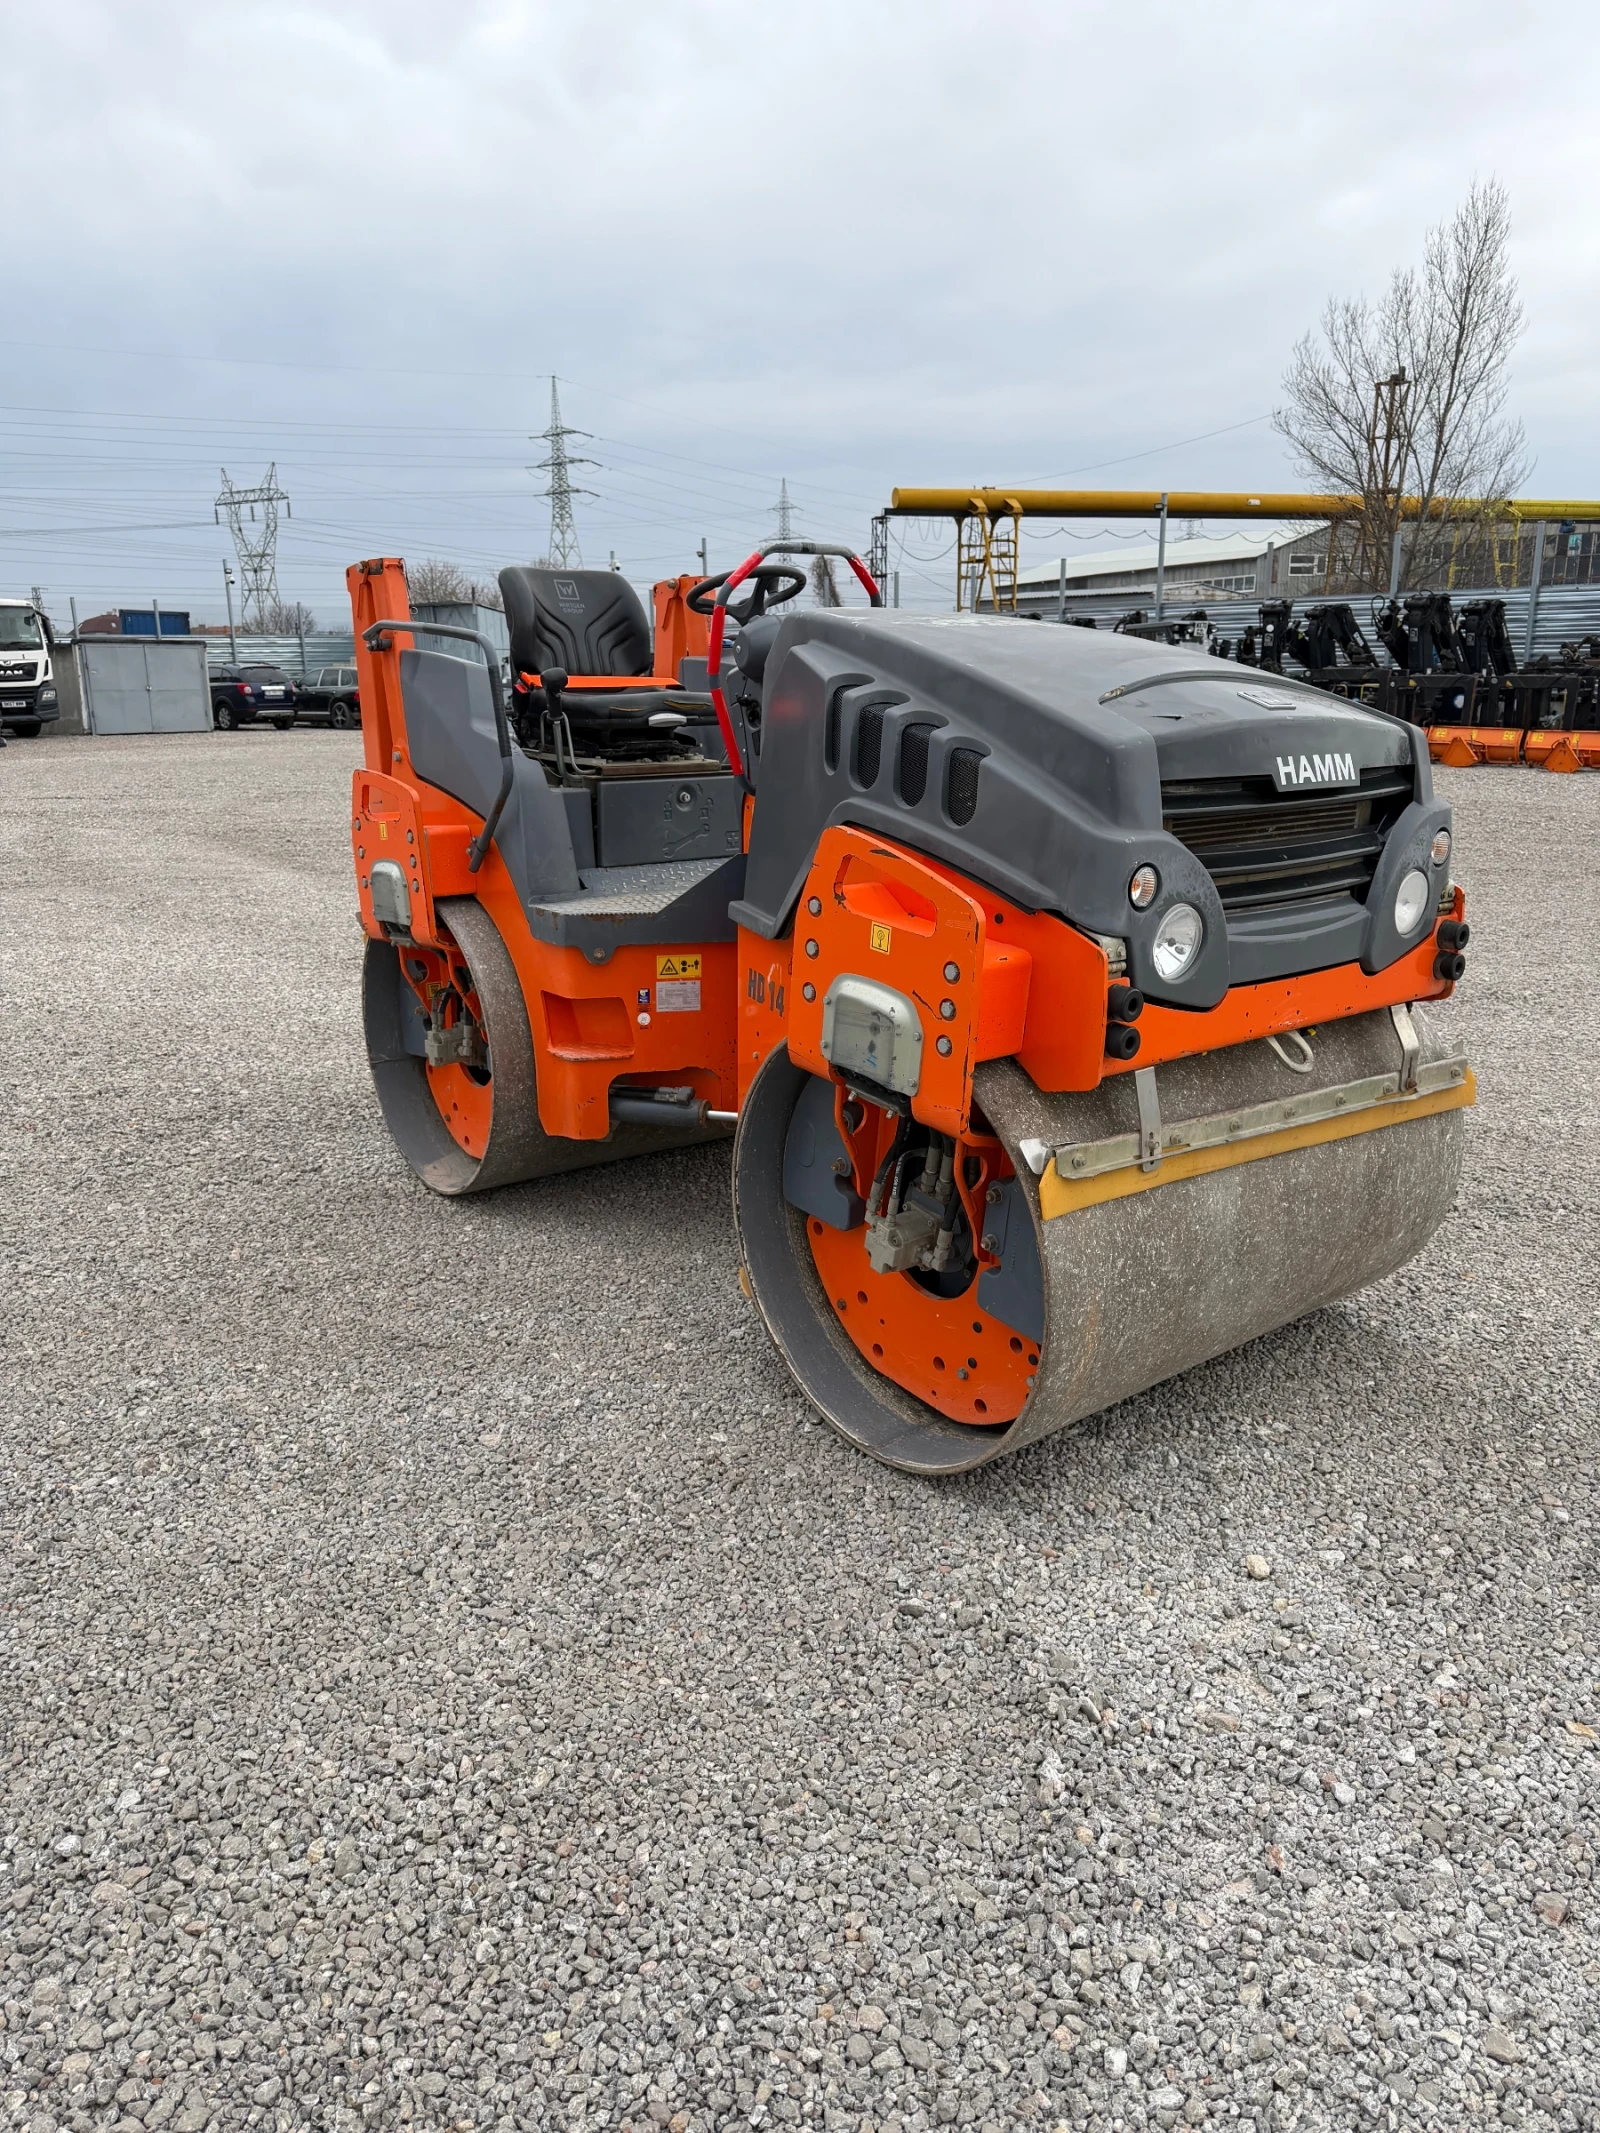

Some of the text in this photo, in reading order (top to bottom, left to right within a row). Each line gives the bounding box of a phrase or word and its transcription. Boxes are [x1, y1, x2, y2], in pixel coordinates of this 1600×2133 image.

[1276, 753, 1356, 785] HAMM
[747, 967, 785, 1018] HD 14
